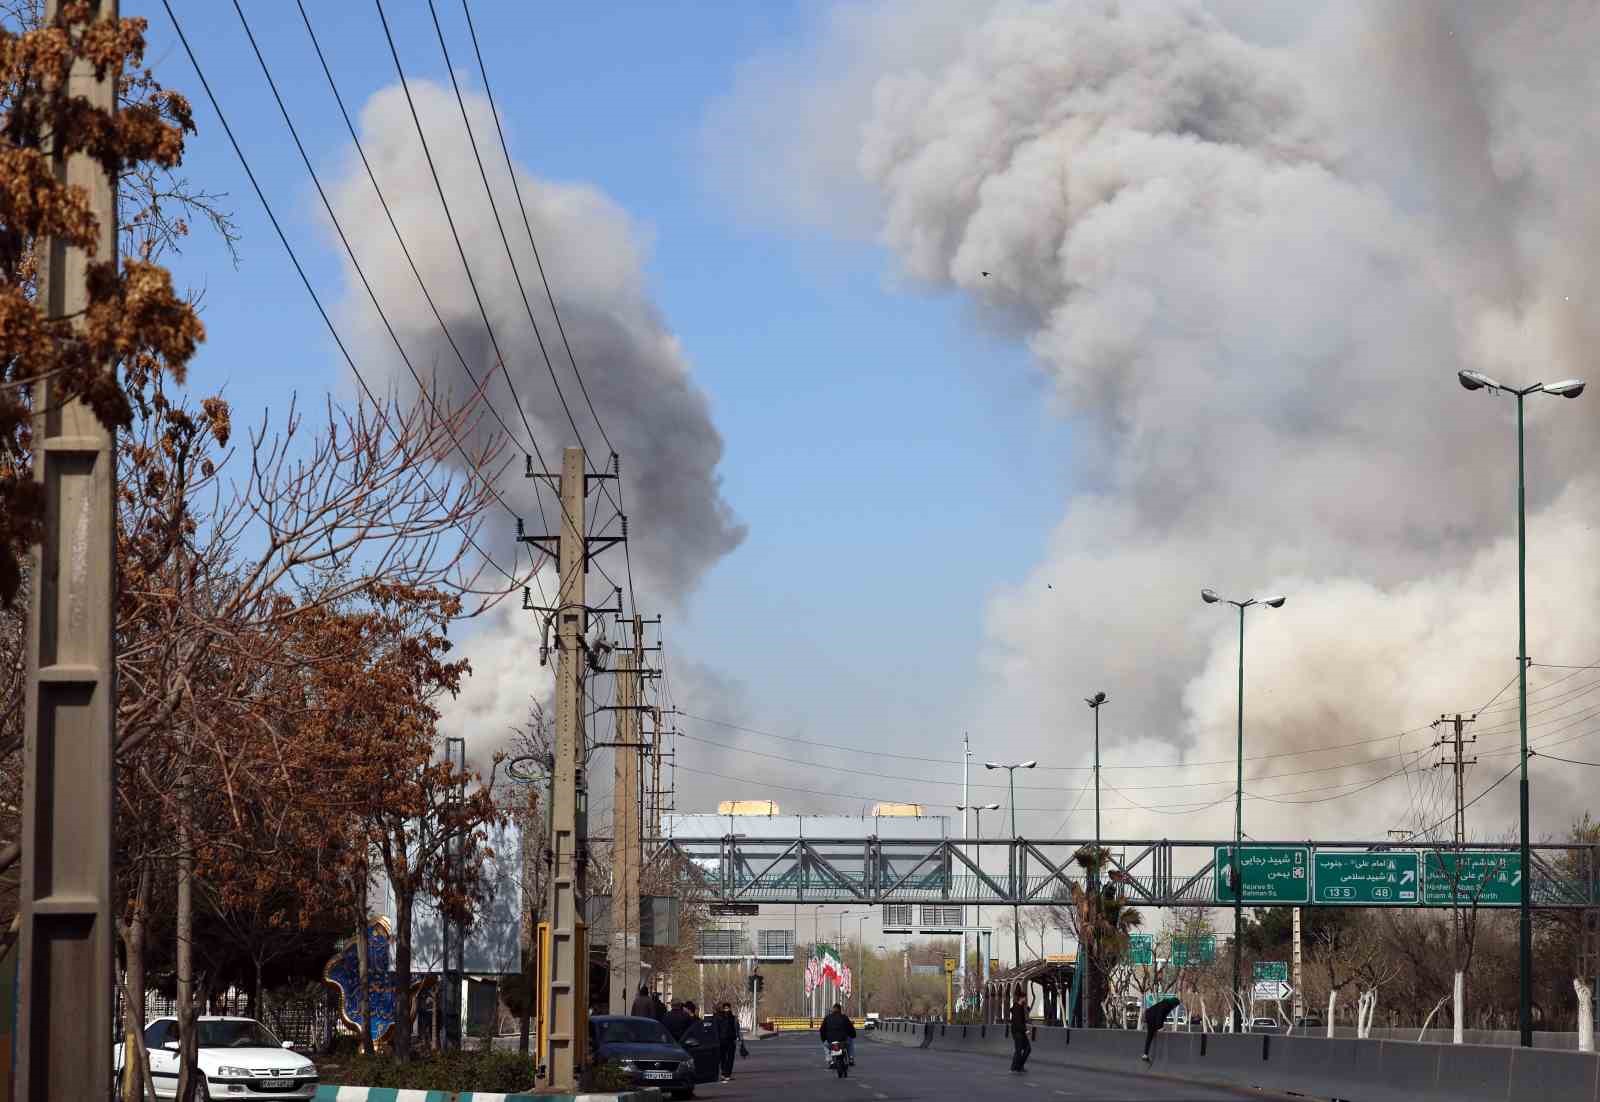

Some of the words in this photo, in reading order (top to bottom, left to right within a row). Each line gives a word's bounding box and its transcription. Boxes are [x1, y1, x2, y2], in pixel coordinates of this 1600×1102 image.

[1267, 854, 1290, 866] شهید
[1320, 860, 1343, 870] جنوب
[1371, 859, 1386, 868] امام
[1267, 868, 1290, 880] بهمن
[1366, 871, 1386, 882] شهید
[1329, 888, 1340, 897] 13
[1343, 888, 1351, 897] S
[1375, 888, 1389, 897] 48
